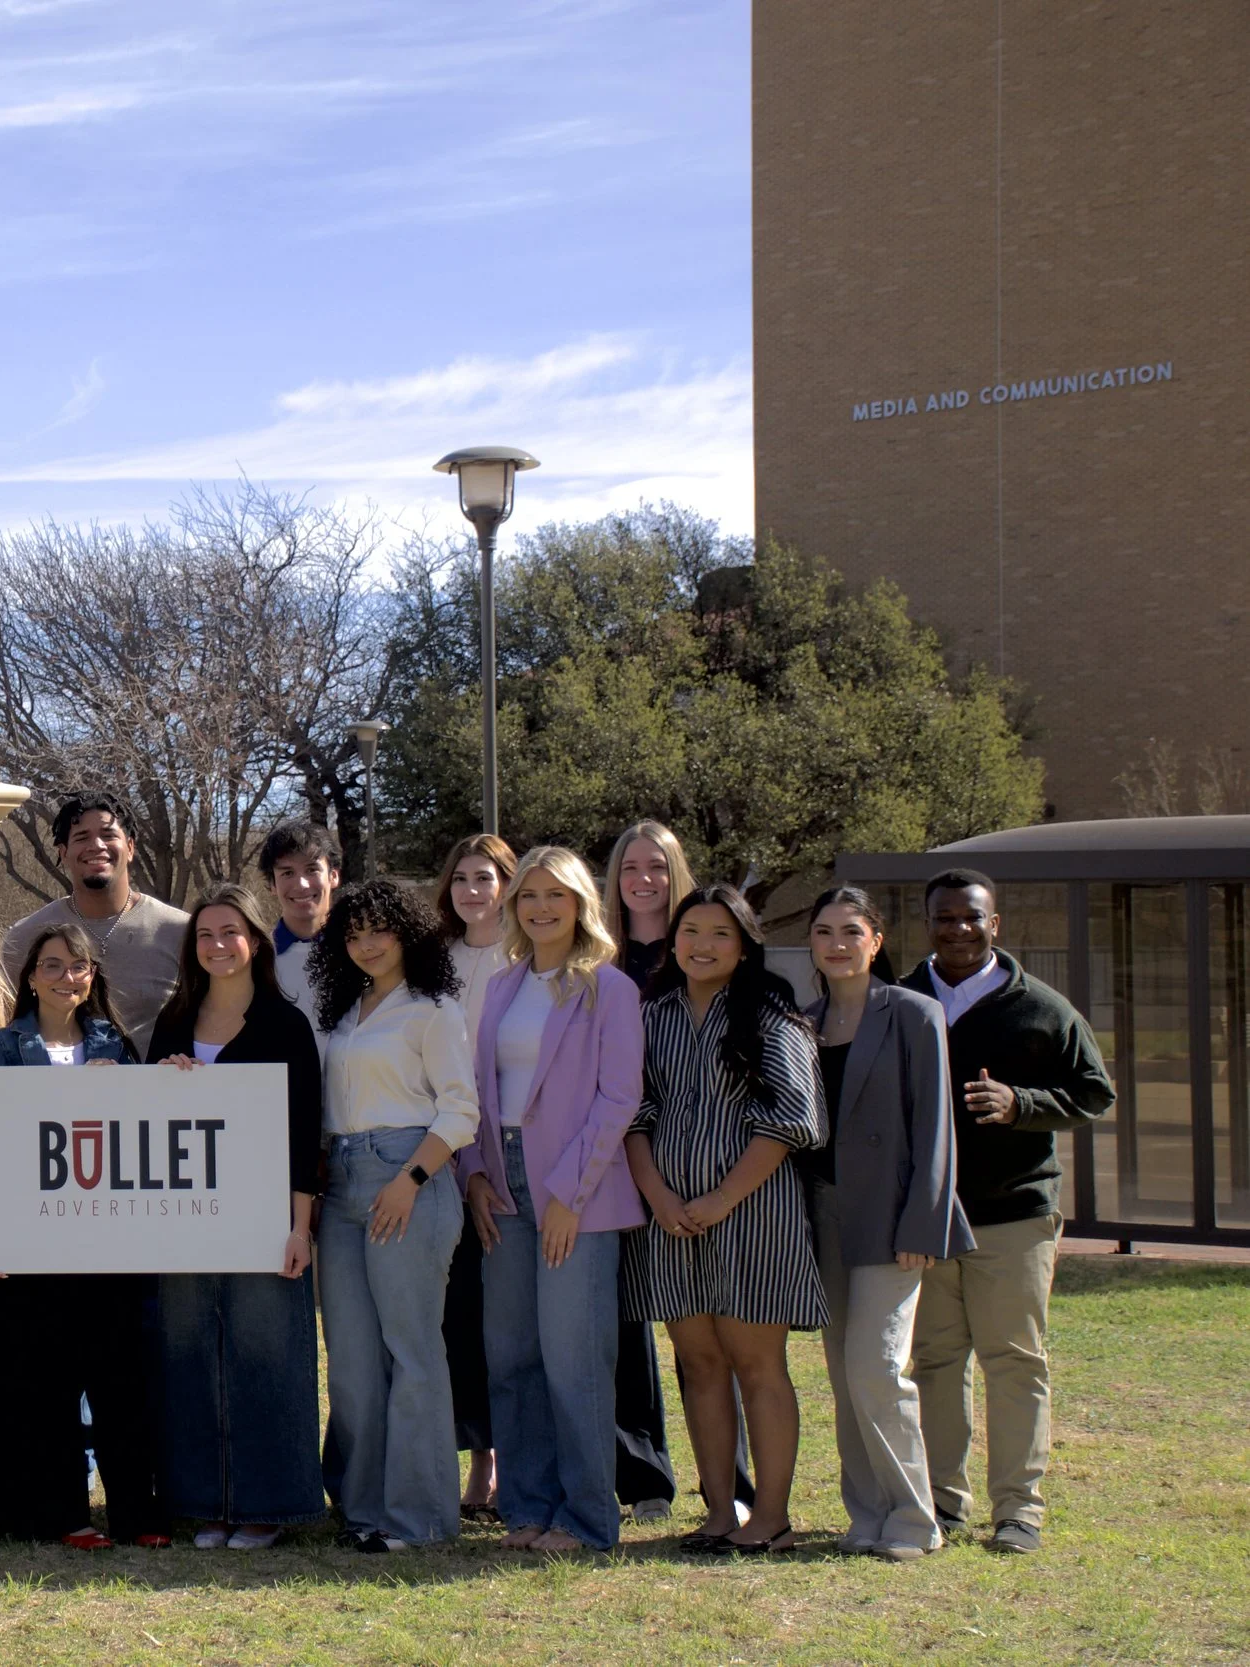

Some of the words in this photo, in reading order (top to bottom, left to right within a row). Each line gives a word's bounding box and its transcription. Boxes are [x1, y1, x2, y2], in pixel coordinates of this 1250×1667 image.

[852, 396, 918, 422] MEDIA
[925, 390, 969, 413] AND
[979, 361, 1173, 405] COMMUNICATION
[39, 1199, 220, 1217] ADVERTISING
